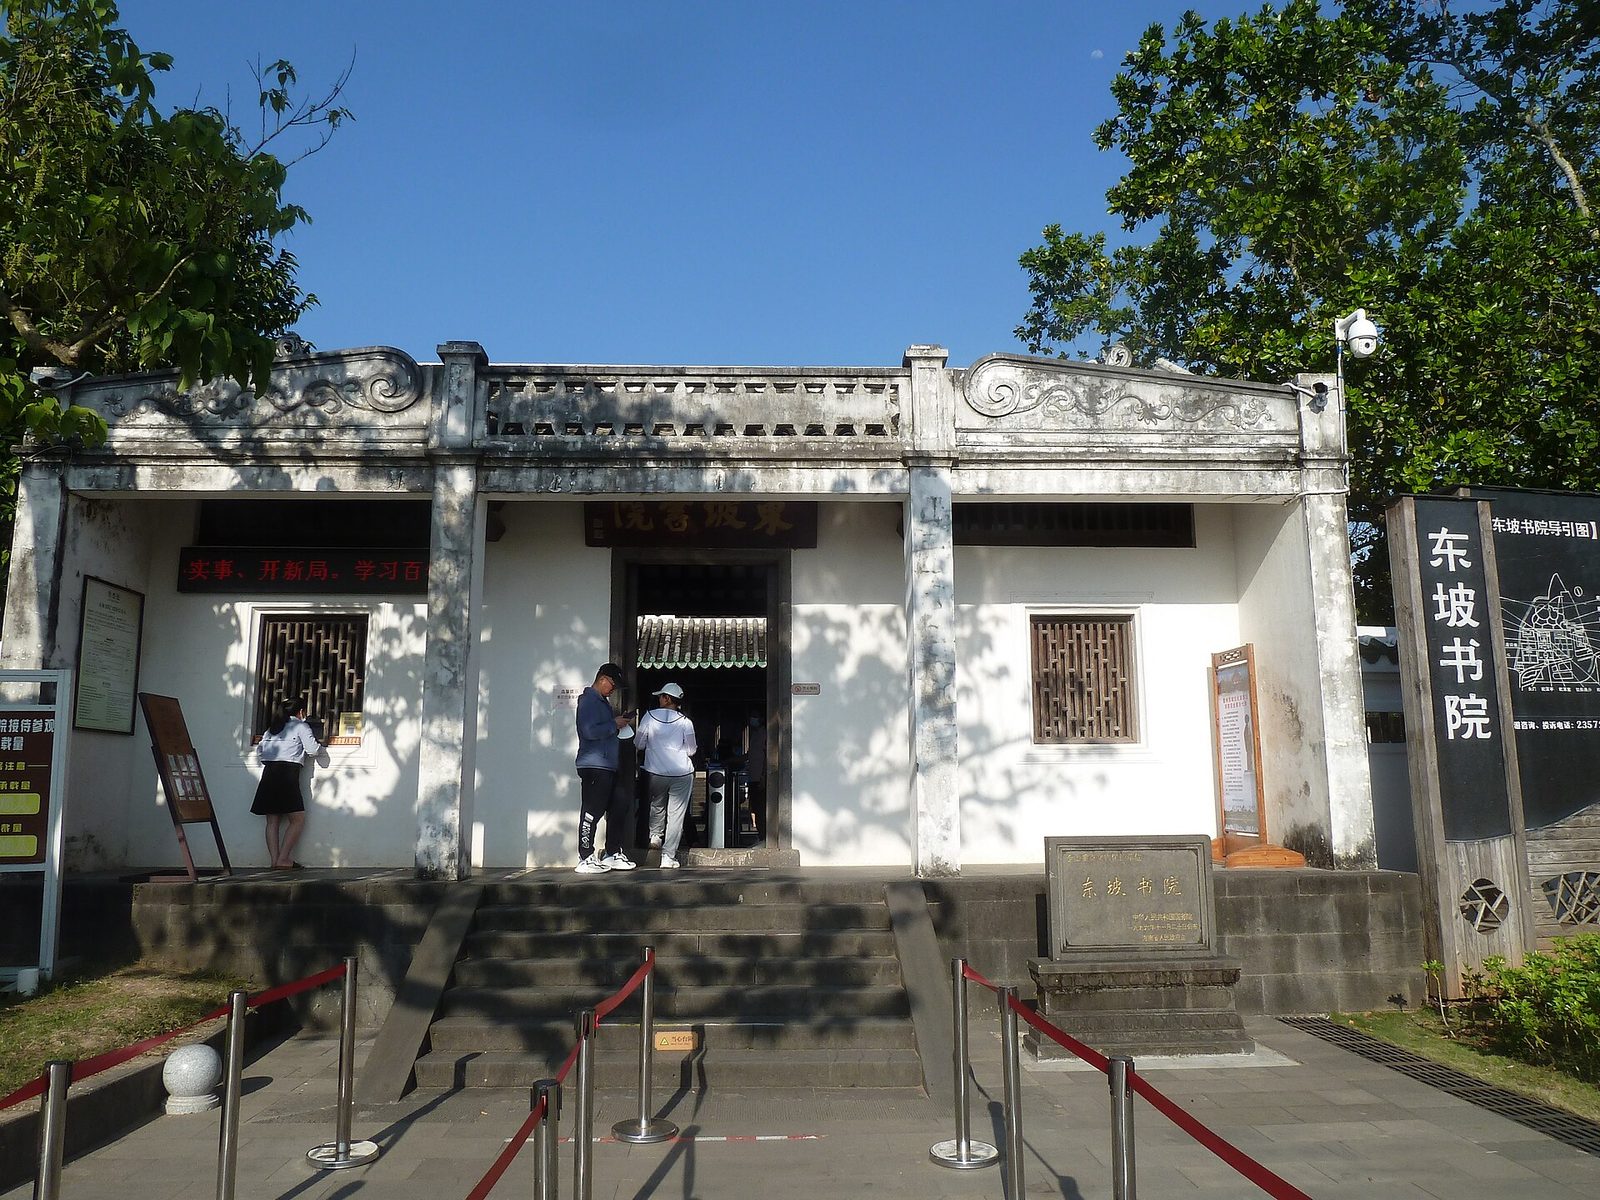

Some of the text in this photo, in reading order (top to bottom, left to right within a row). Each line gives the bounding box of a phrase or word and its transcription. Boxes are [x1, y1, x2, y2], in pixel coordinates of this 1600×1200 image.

[1428, 527, 1492, 740] 东坡书院
[1082, 876, 1182, 899] 东坡书院
